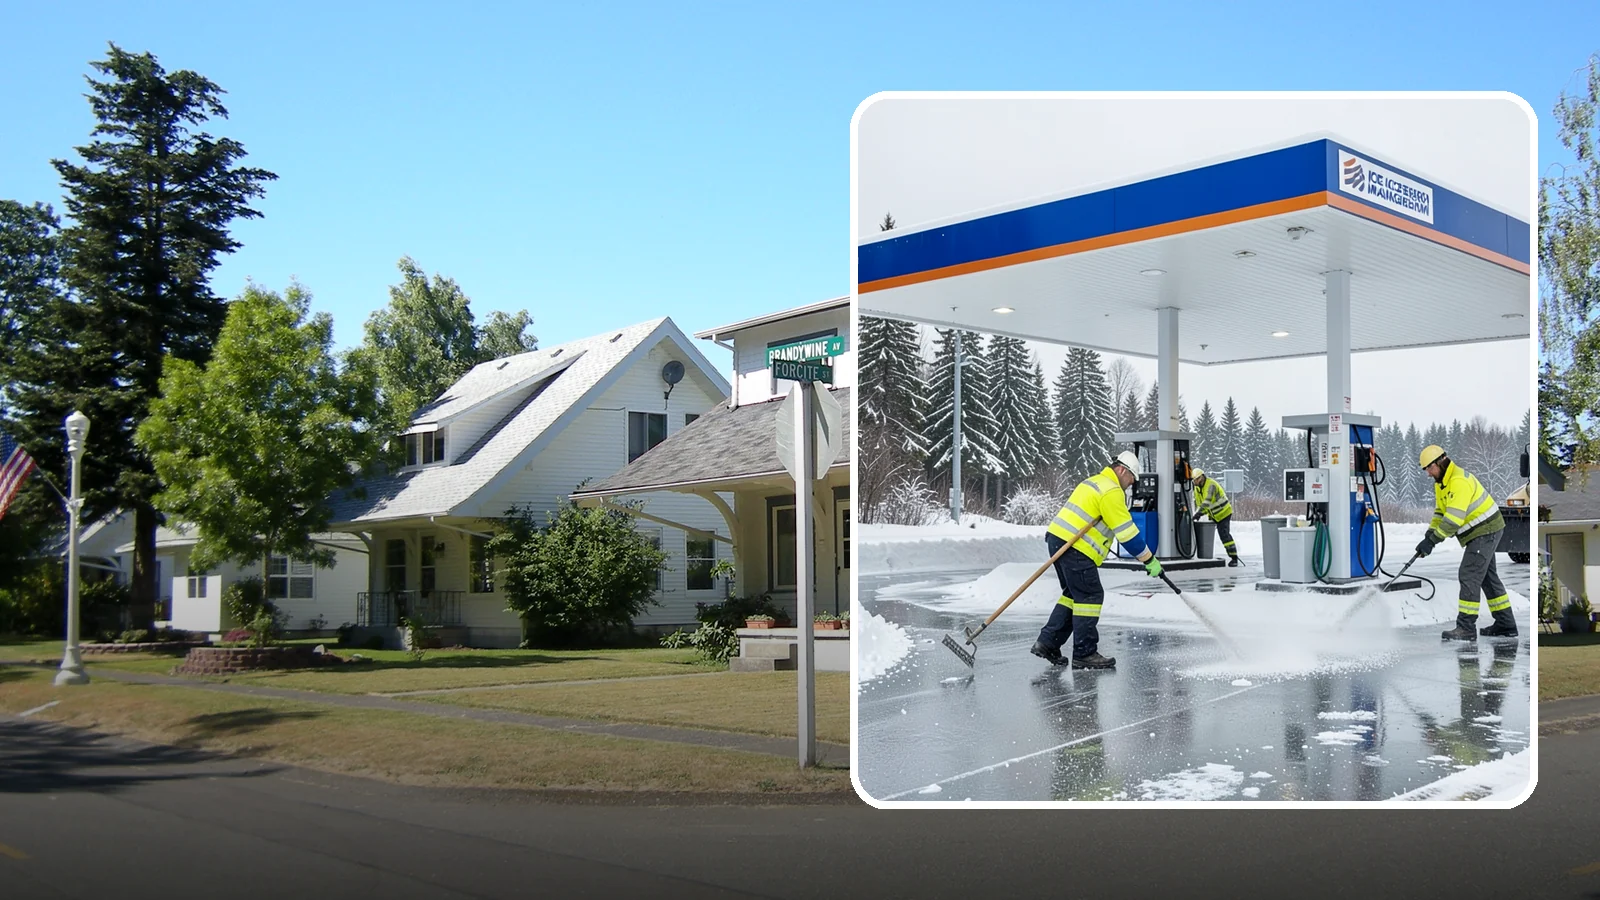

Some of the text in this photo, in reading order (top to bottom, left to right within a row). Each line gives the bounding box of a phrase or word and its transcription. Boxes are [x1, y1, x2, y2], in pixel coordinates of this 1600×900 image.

[769, 341, 841, 364] BRANDYWINE AV
[775, 363, 830, 380] FORCITE ST
